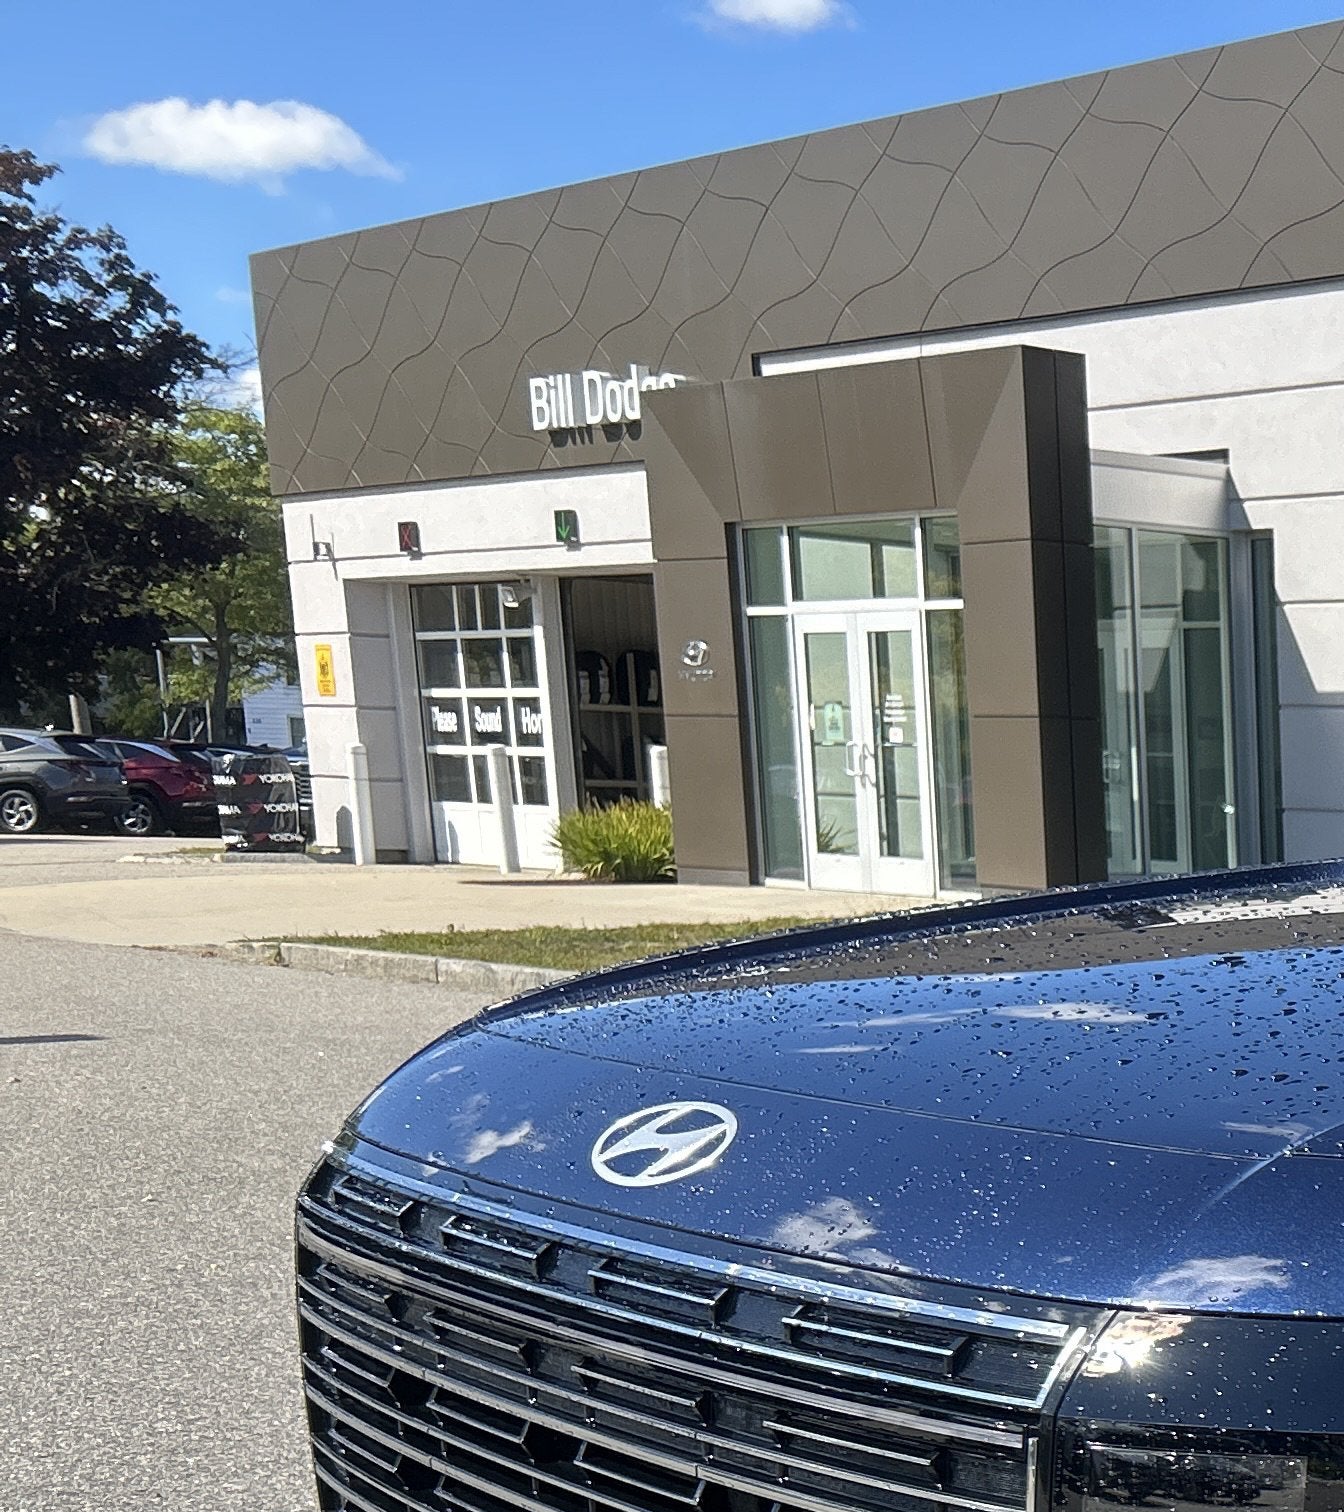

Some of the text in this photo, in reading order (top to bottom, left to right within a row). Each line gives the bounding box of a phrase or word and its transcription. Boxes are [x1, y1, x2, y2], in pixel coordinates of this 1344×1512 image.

[529, 363, 677, 431] Bill Dod
[474, 705, 503, 732] Sound
